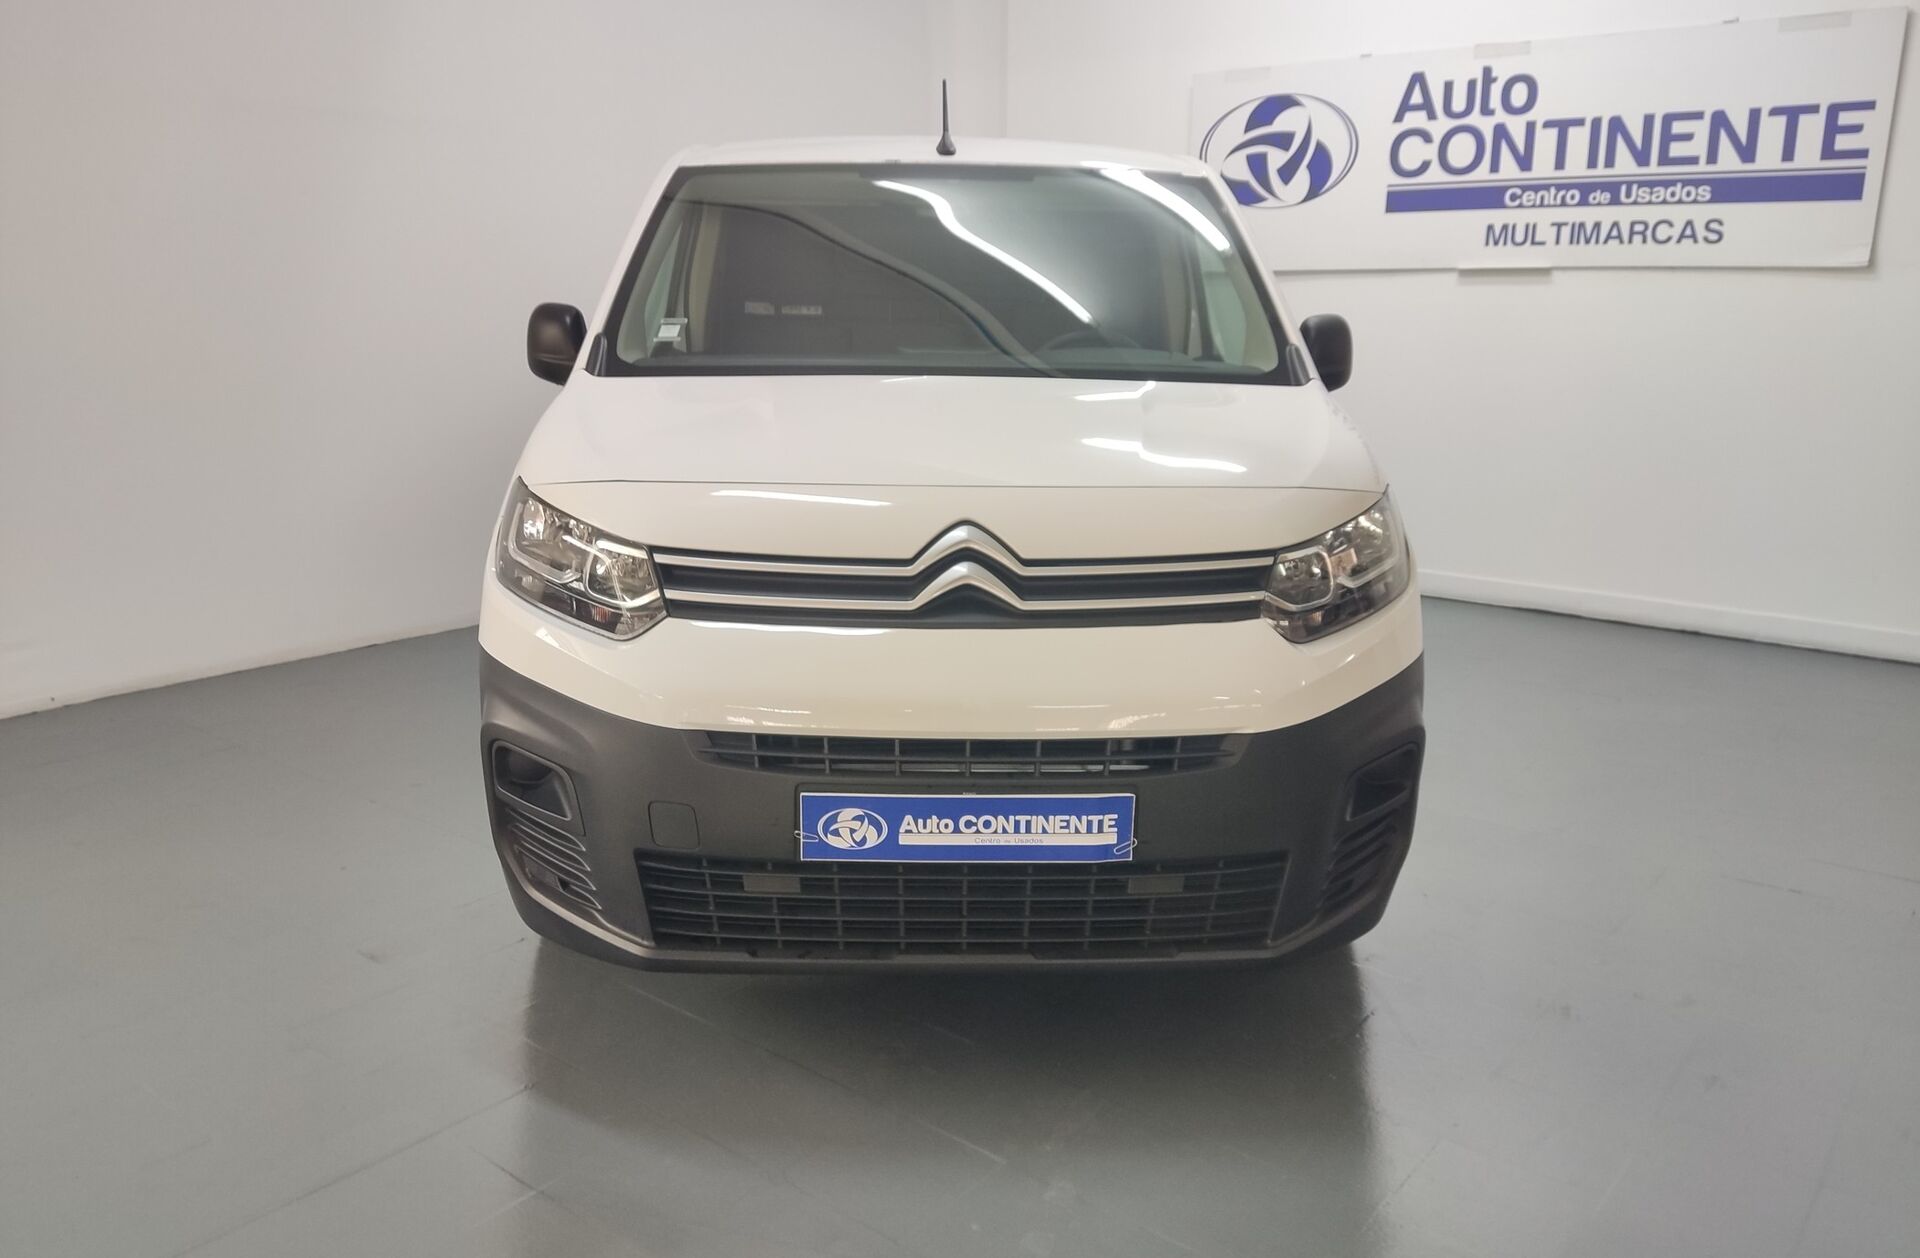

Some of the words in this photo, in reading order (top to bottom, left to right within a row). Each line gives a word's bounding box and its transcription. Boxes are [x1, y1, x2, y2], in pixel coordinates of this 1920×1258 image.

[1392, 65, 1539, 123] Auto
[1389, 100, 1876, 178] CONTINENTE
[1503, 186, 1581, 208] Centro
[1588, 190, 1611, 205] de
[1619, 182, 1712, 204] Usados
[1484, 219, 1725, 247] MULTIMARCAS
[899, 814, 954, 834] Auto
[959, 814, 1118, 834] CONTINENTE
